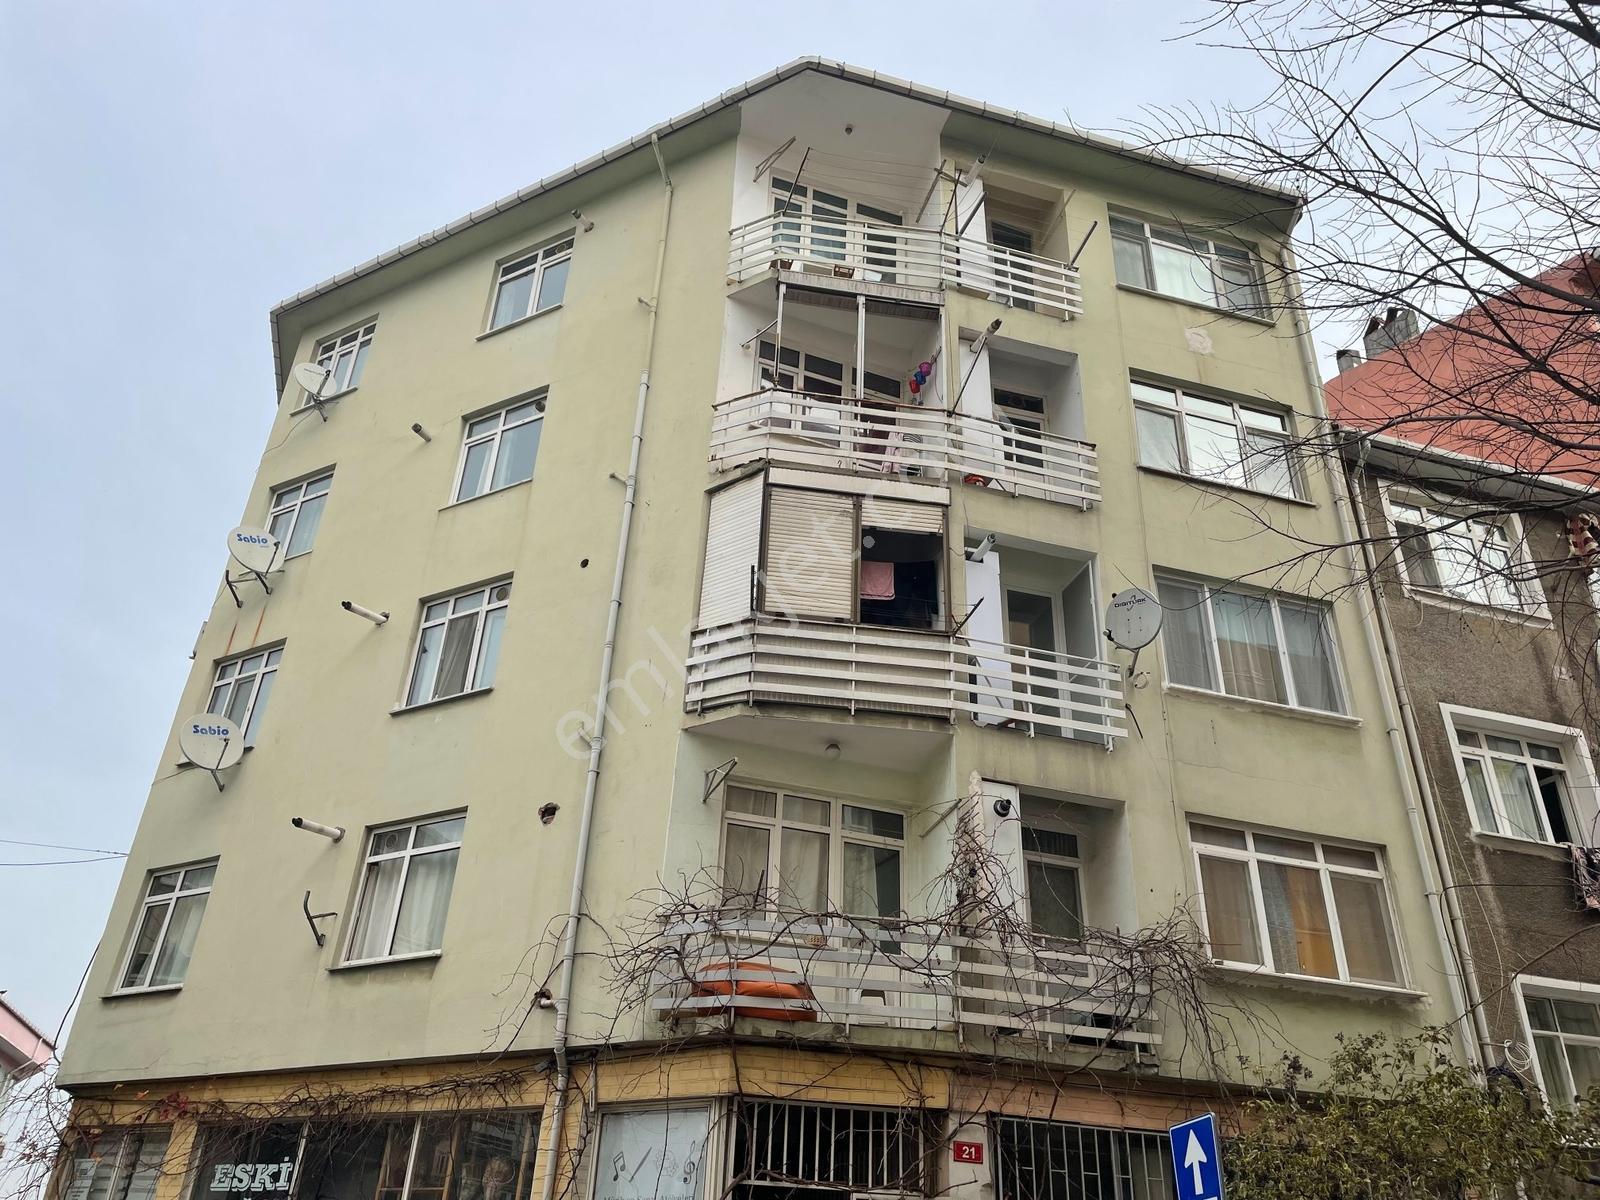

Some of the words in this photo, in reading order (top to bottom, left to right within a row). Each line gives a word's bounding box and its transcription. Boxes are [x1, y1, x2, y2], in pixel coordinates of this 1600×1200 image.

[236, 533, 268, 544] Sabio
[192, 724, 230, 736] Sabio
[962, 1146, 976, 1159] 21
[210, 1156, 294, 1192] ESKİ
